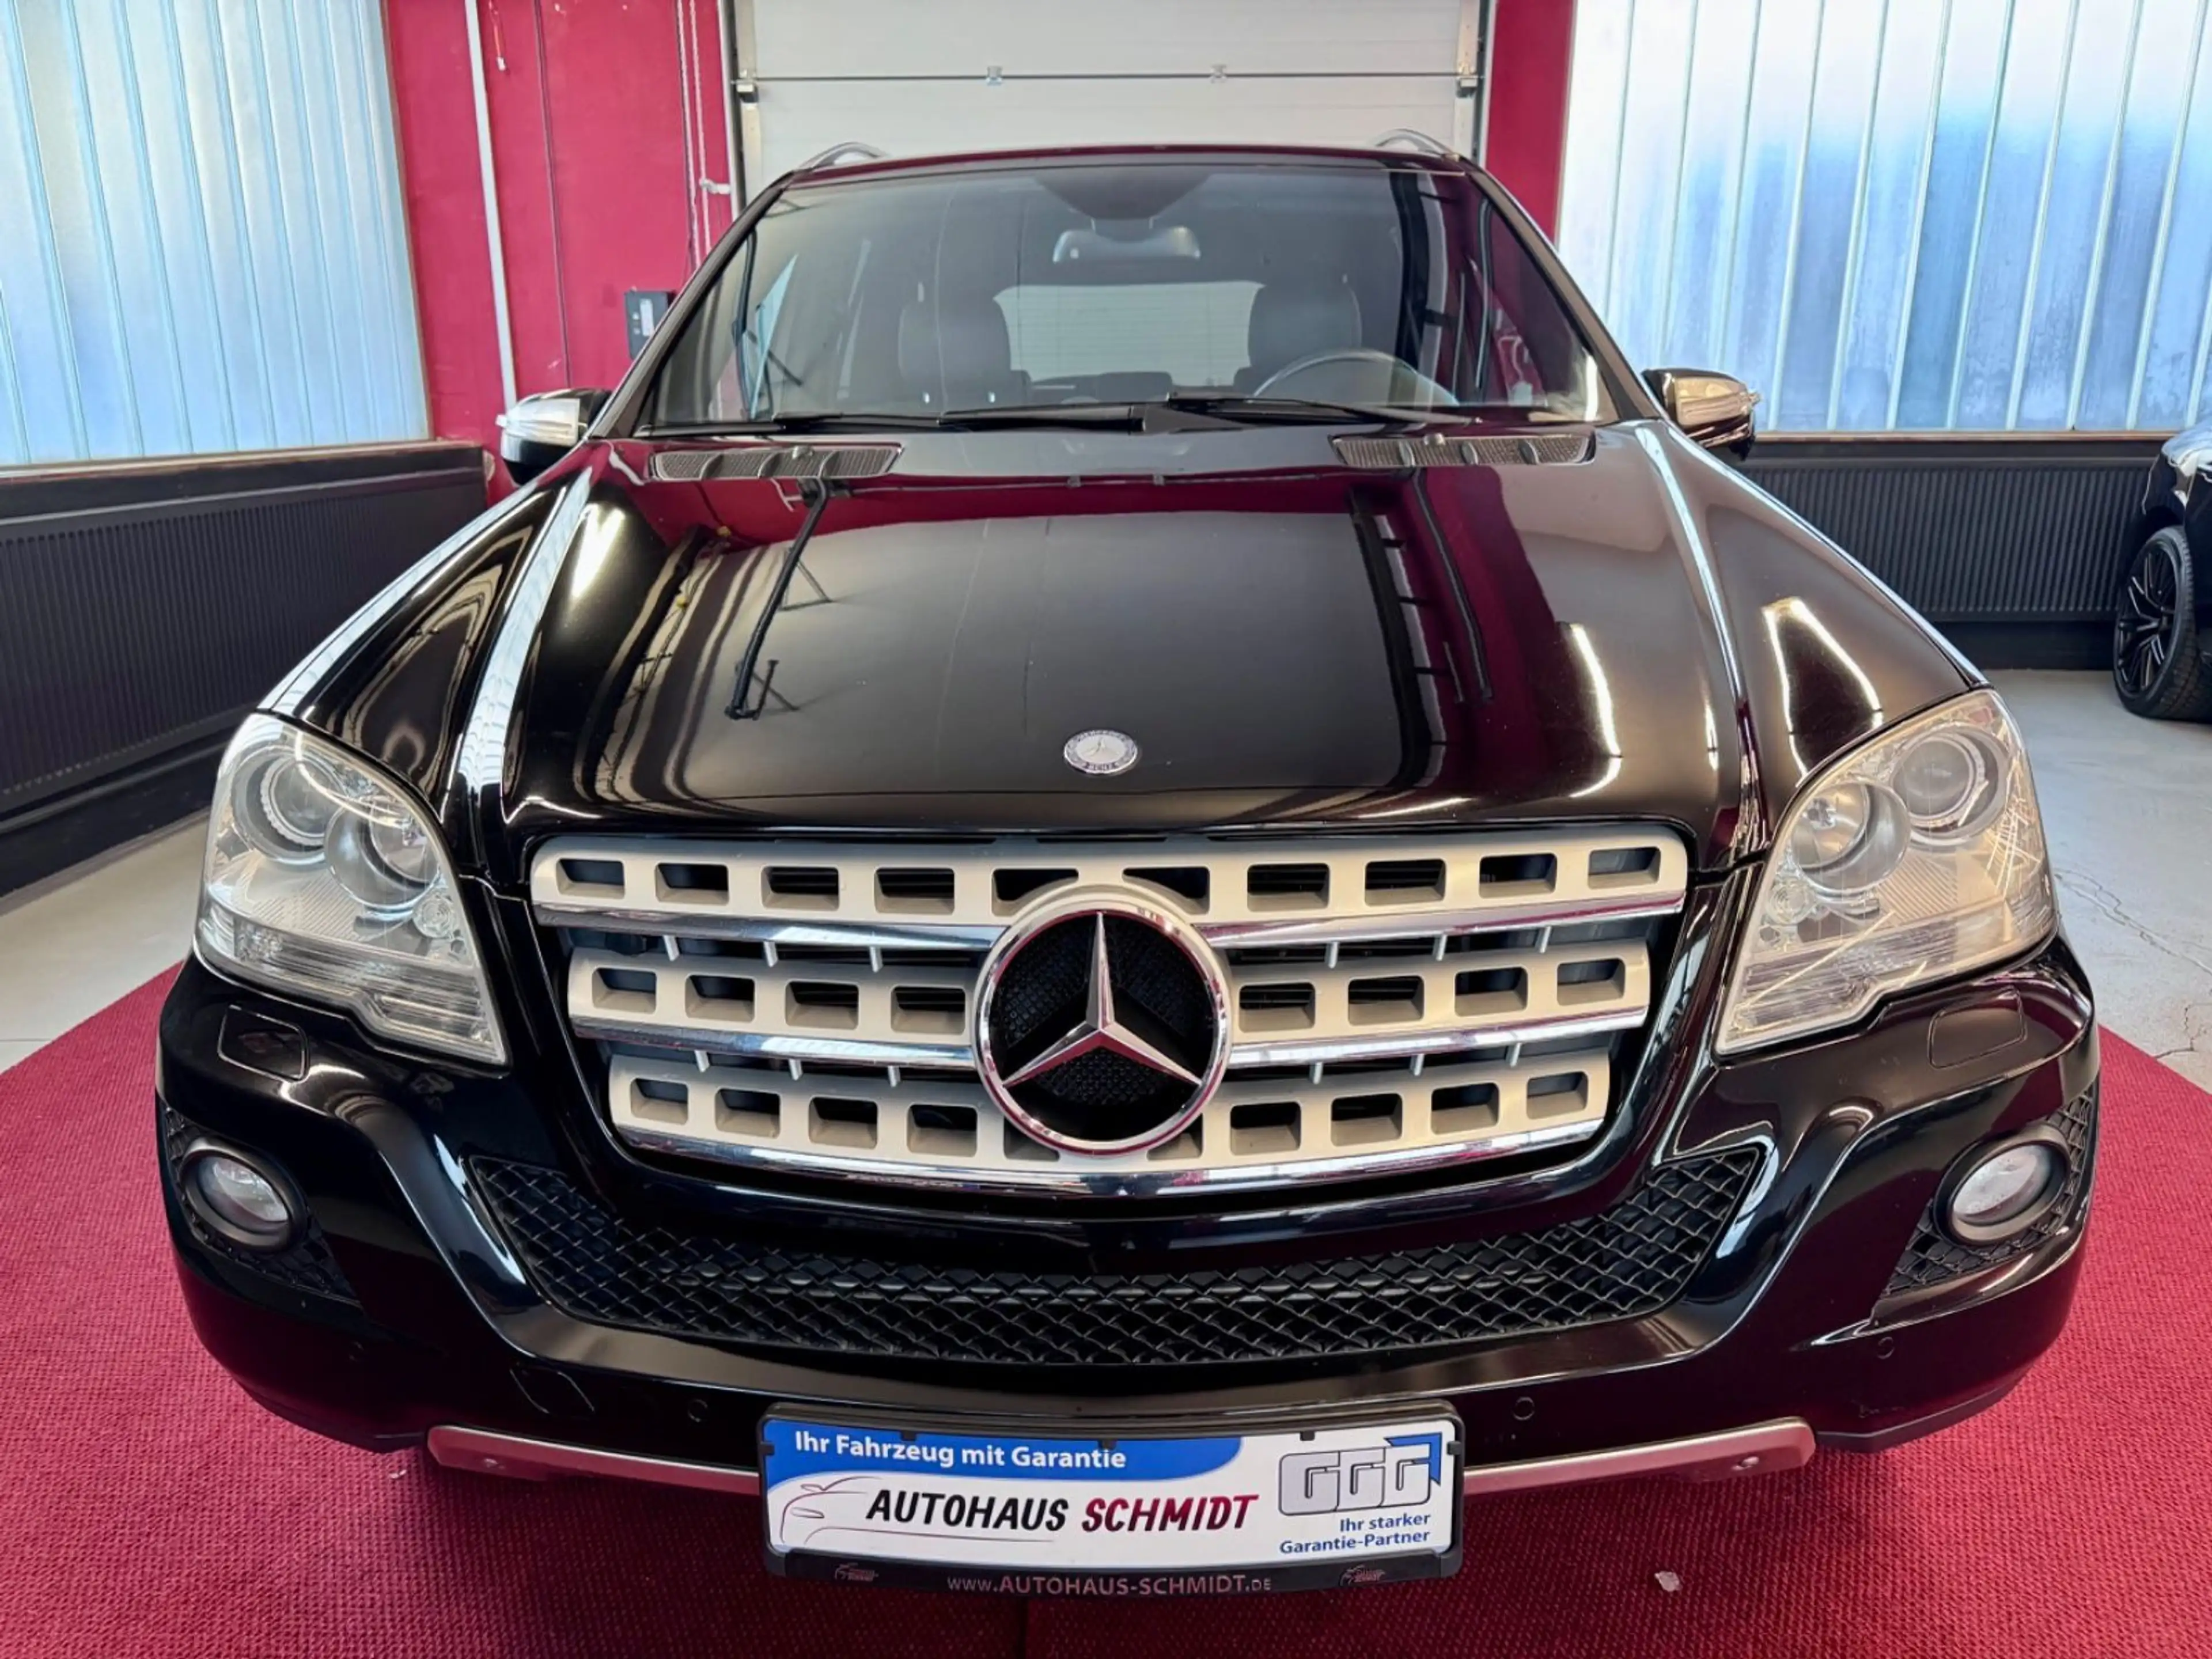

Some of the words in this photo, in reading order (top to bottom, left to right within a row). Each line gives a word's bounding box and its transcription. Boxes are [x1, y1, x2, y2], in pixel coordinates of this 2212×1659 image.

[795, 1430, 830, 1453] Ihr
[836, 1434, 954, 1468] Fahrzeug
[961, 1444, 1005, 1466] mit
[1011, 1446, 1127, 1468] Garantie
[865, 1489, 1069, 1532] AUTOHAUS
[1081, 1494, 1260, 1532] SCHMIDT
[1339, 1517, 1365, 1532] Ihr
[1368, 1513, 1431, 1530] starker
[1279, 1530, 1430, 1554] Garantie-Partner
